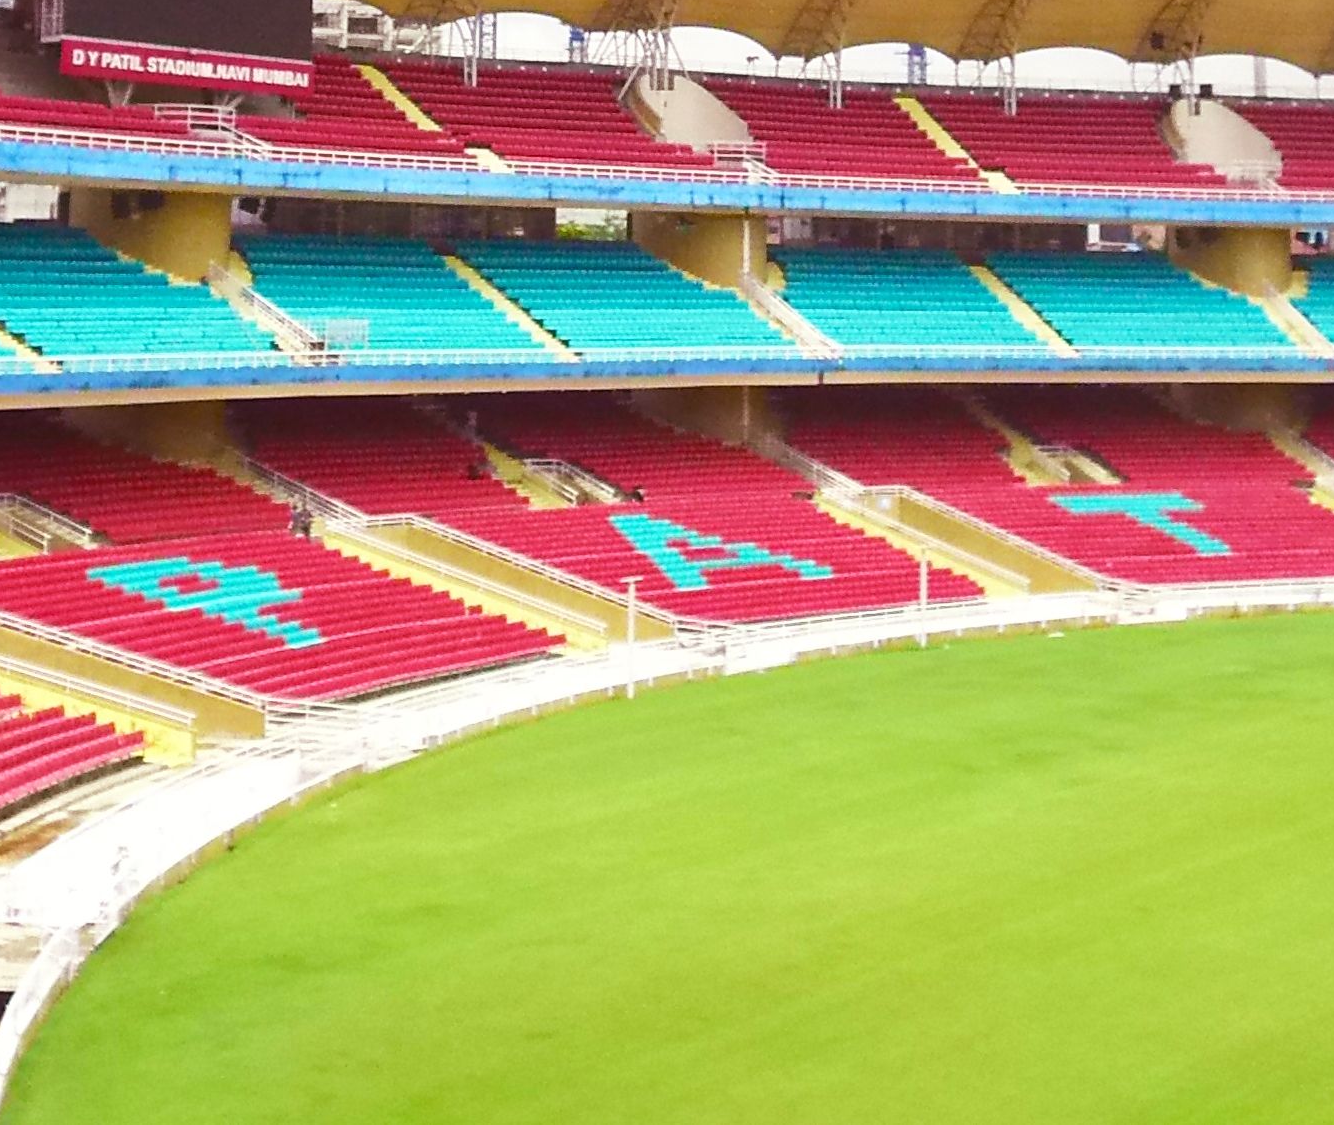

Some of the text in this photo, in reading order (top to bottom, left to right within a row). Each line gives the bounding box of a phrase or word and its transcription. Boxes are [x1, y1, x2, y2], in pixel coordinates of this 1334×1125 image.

[72, 49, 84, 66] D
[88, 51, 99, 67] Y
[101, 52, 145, 72] PATIL
[252, 67, 310, 88] MUMBAI
